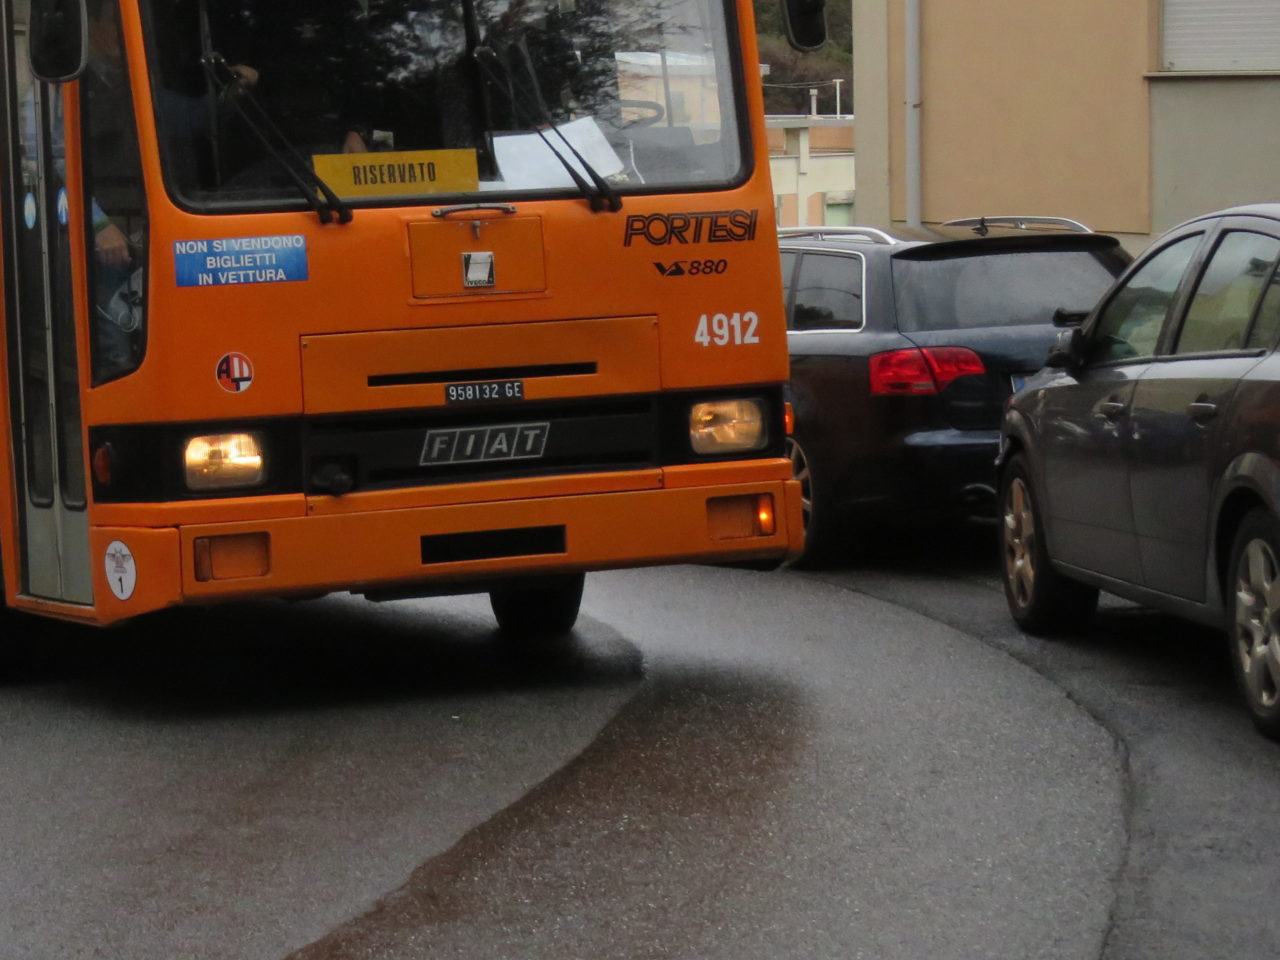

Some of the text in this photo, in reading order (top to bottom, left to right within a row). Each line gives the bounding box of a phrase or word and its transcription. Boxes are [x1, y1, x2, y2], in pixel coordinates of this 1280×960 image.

[352, 161, 437, 186] RISERVATO
[623, 209, 759, 247] PORTESI
[176, 235, 304, 255] NON SI VENDONO
[206, 252, 277, 269] BIGLIETTI
[198, 268, 287, 286] IN VETTURA
[694, 311, 760, 347] 4912
[449, 382, 522, 401] 958132 GE
[428, 428, 542, 459] FIAT
